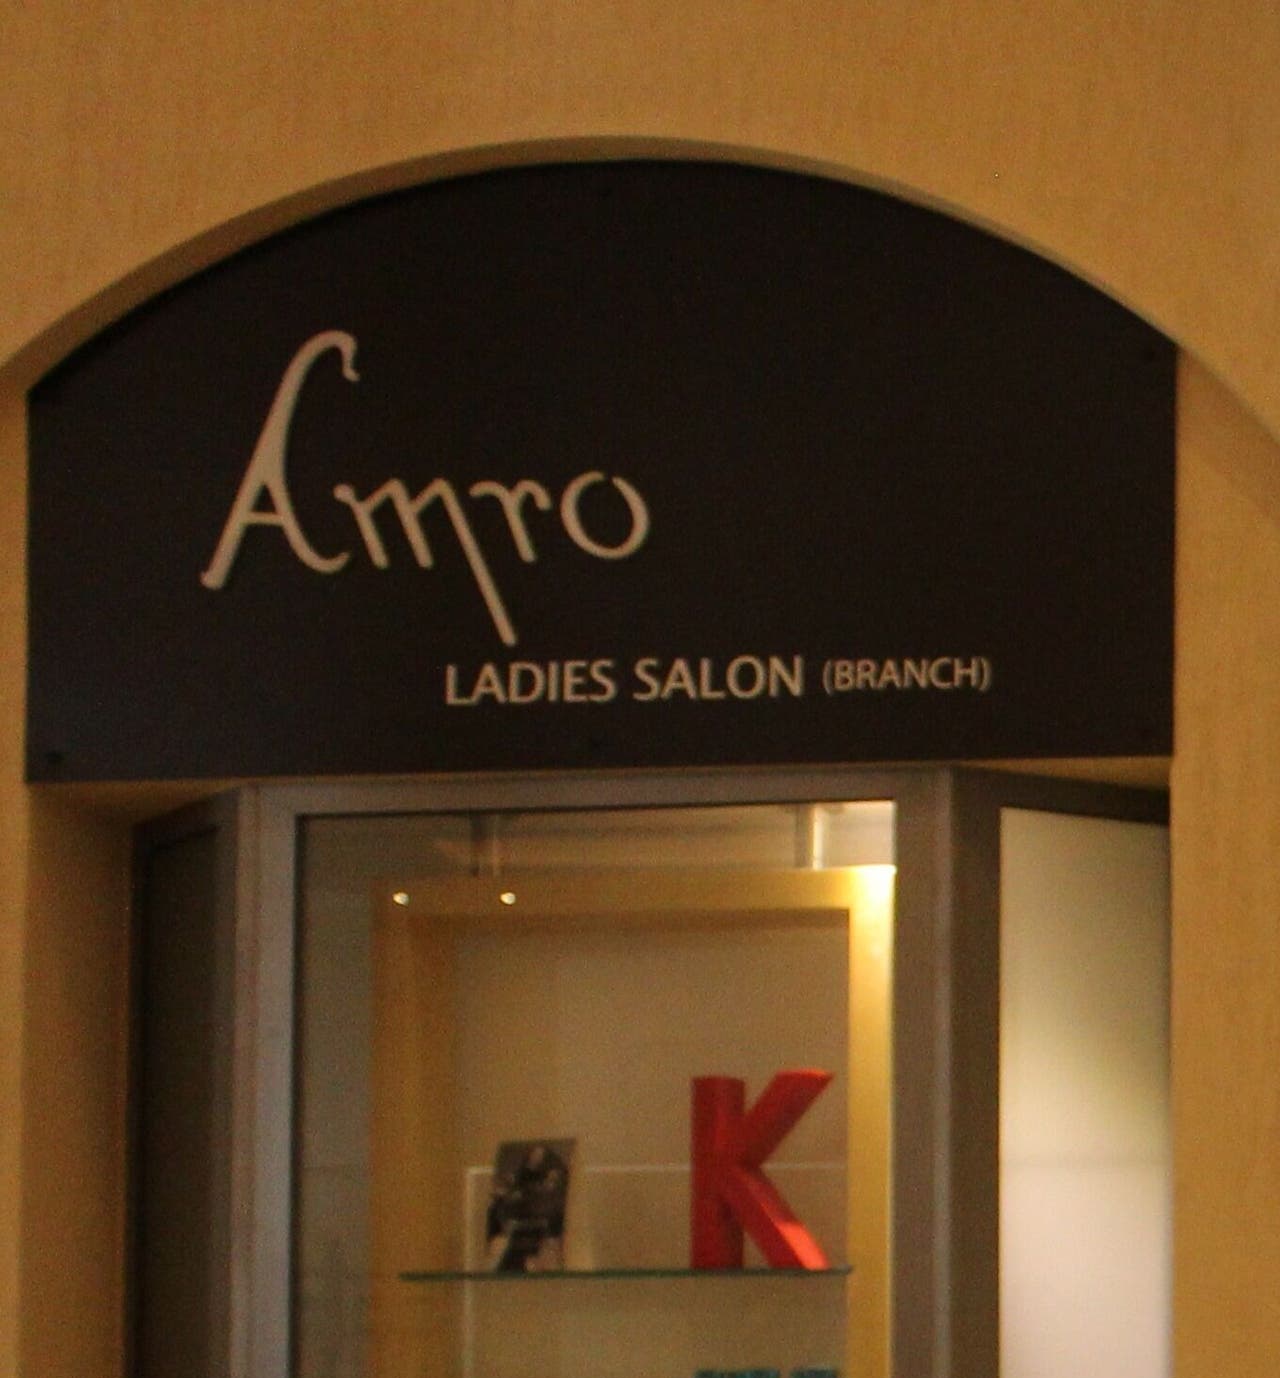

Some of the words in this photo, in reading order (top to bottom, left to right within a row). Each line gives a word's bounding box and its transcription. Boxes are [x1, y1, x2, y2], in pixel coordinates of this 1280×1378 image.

[200, 330, 650, 647] Amro
[446, 659, 617, 706] LADIES
[633, 655, 804, 702] SALON
[822, 656, 991, 695] (BRANCH)
[690, 1069, 835, 1270] K
